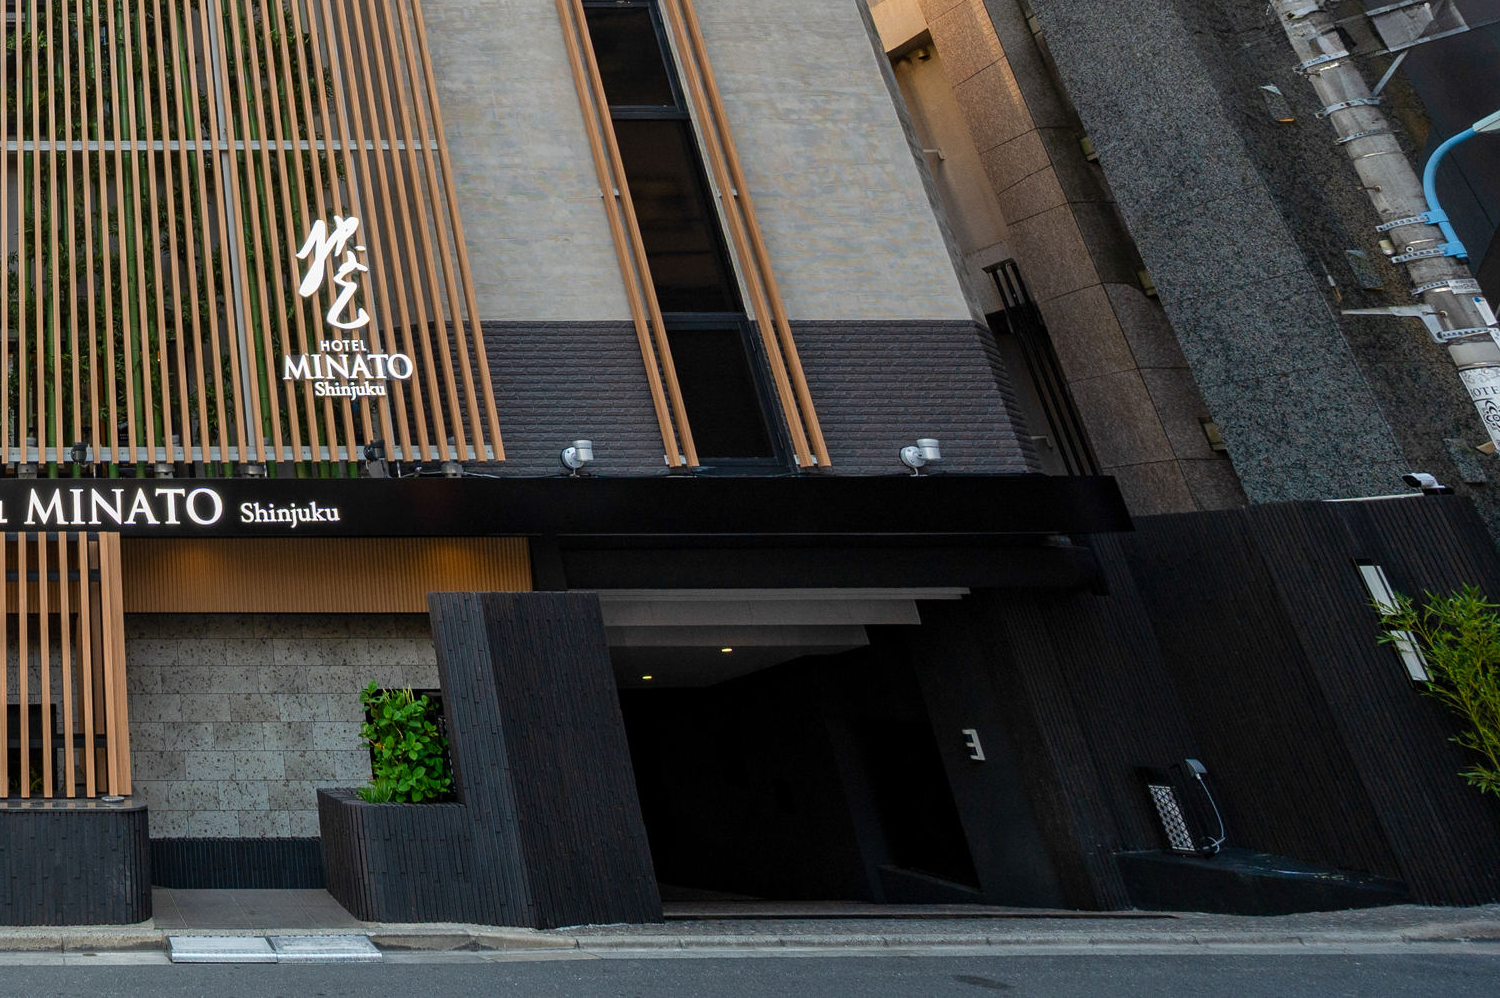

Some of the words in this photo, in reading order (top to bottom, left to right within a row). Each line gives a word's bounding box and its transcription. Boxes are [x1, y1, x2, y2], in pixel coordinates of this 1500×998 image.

[320, 339, 368, 352] HOTEL
[283, 353, 414, 380] MINATO
[314, 381, 387, 401] Shinjuku
[1470, 386, 1500, 398] OTE
[23, 487, 223, 526] MINATO
[240, 501, 341, 528] Shinjuku
